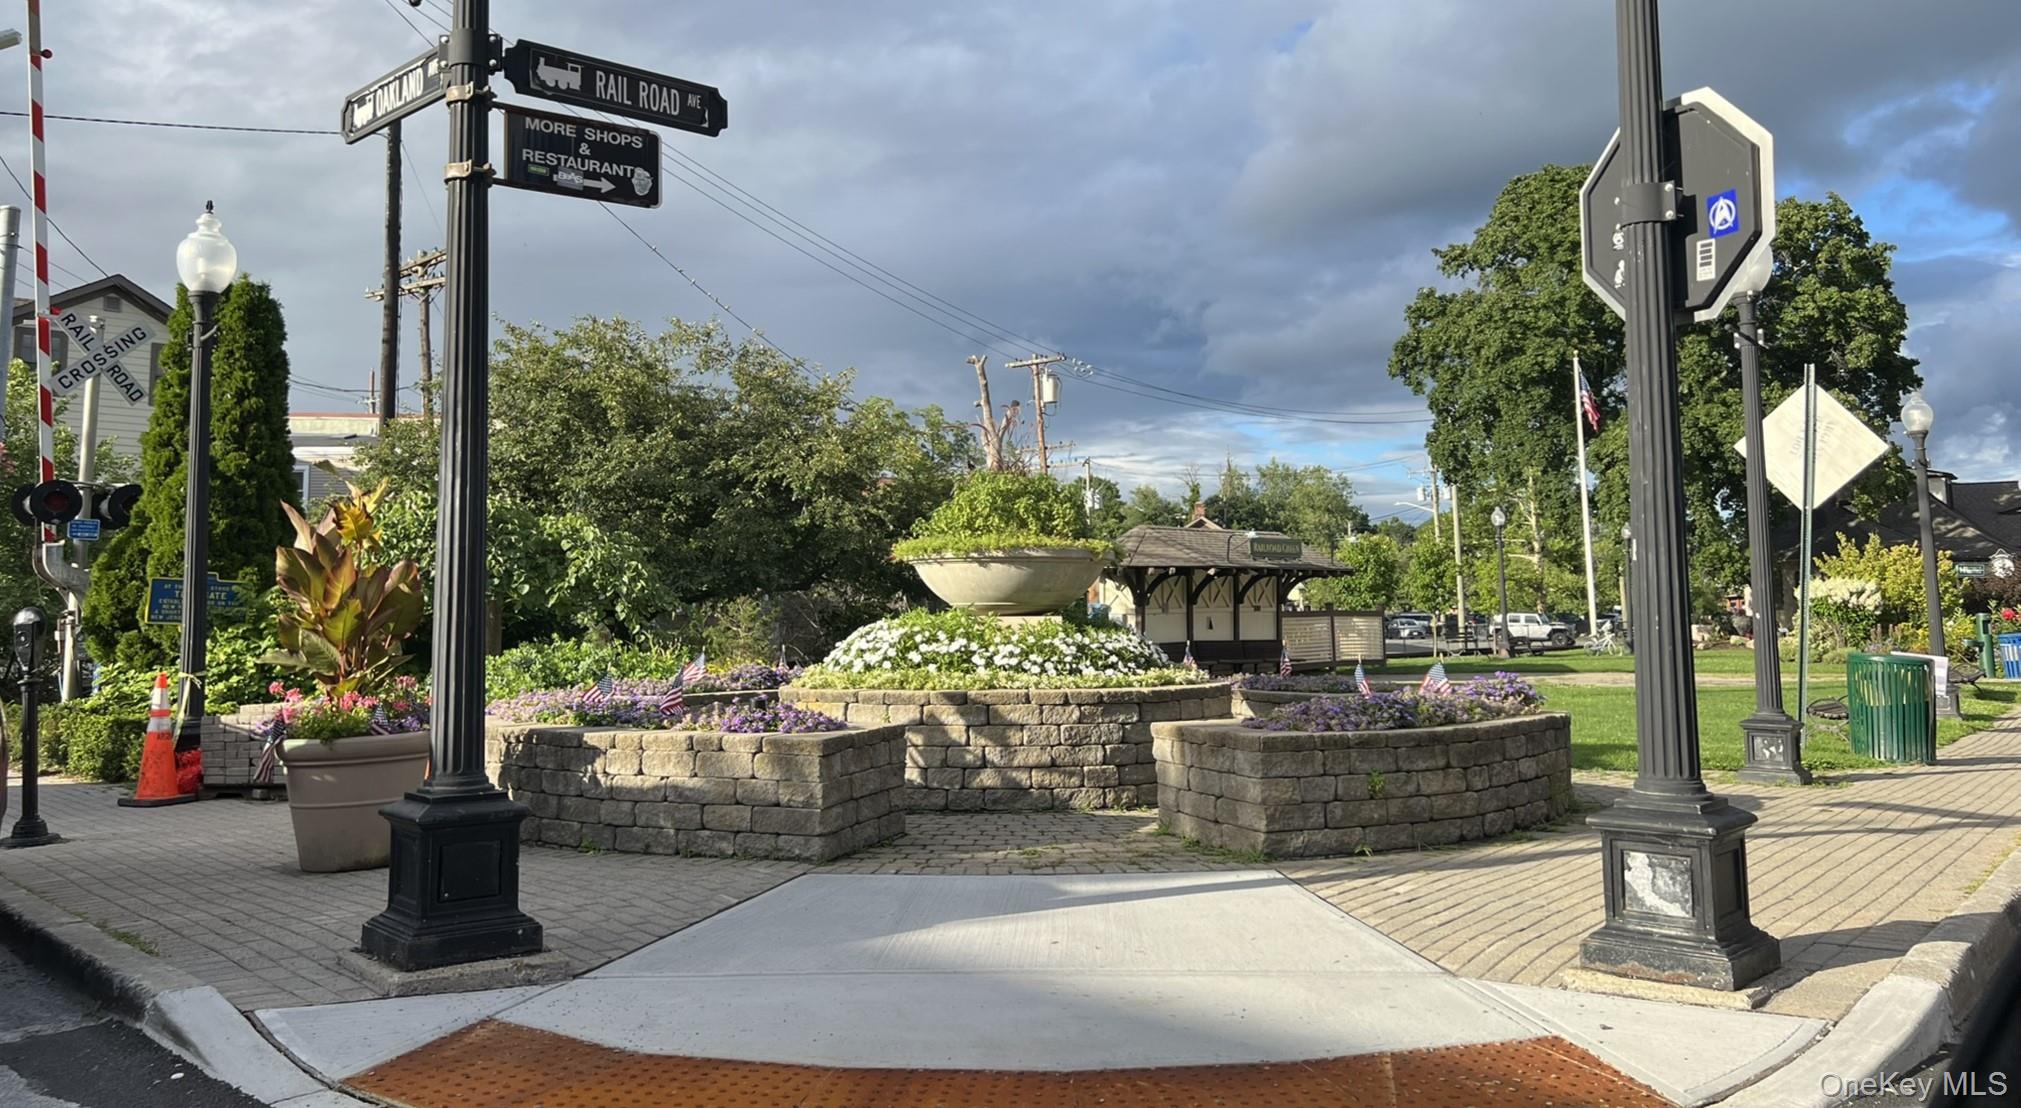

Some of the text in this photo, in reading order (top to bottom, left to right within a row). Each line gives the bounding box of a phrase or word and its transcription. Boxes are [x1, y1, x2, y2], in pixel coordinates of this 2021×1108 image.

[375, 67, 424, 117] OAKLAND
[595, 70, 702, 116] RAIL ROAD AVE
[525, 117, 643, 149] MORE SHOPS
[579, 142, 592, 156] &
[522, 149, 637, 178] RESTAURANT
[58, 327, 147, 389] CROSSING
[61, 313, 144, 402] RAIL ROAD
